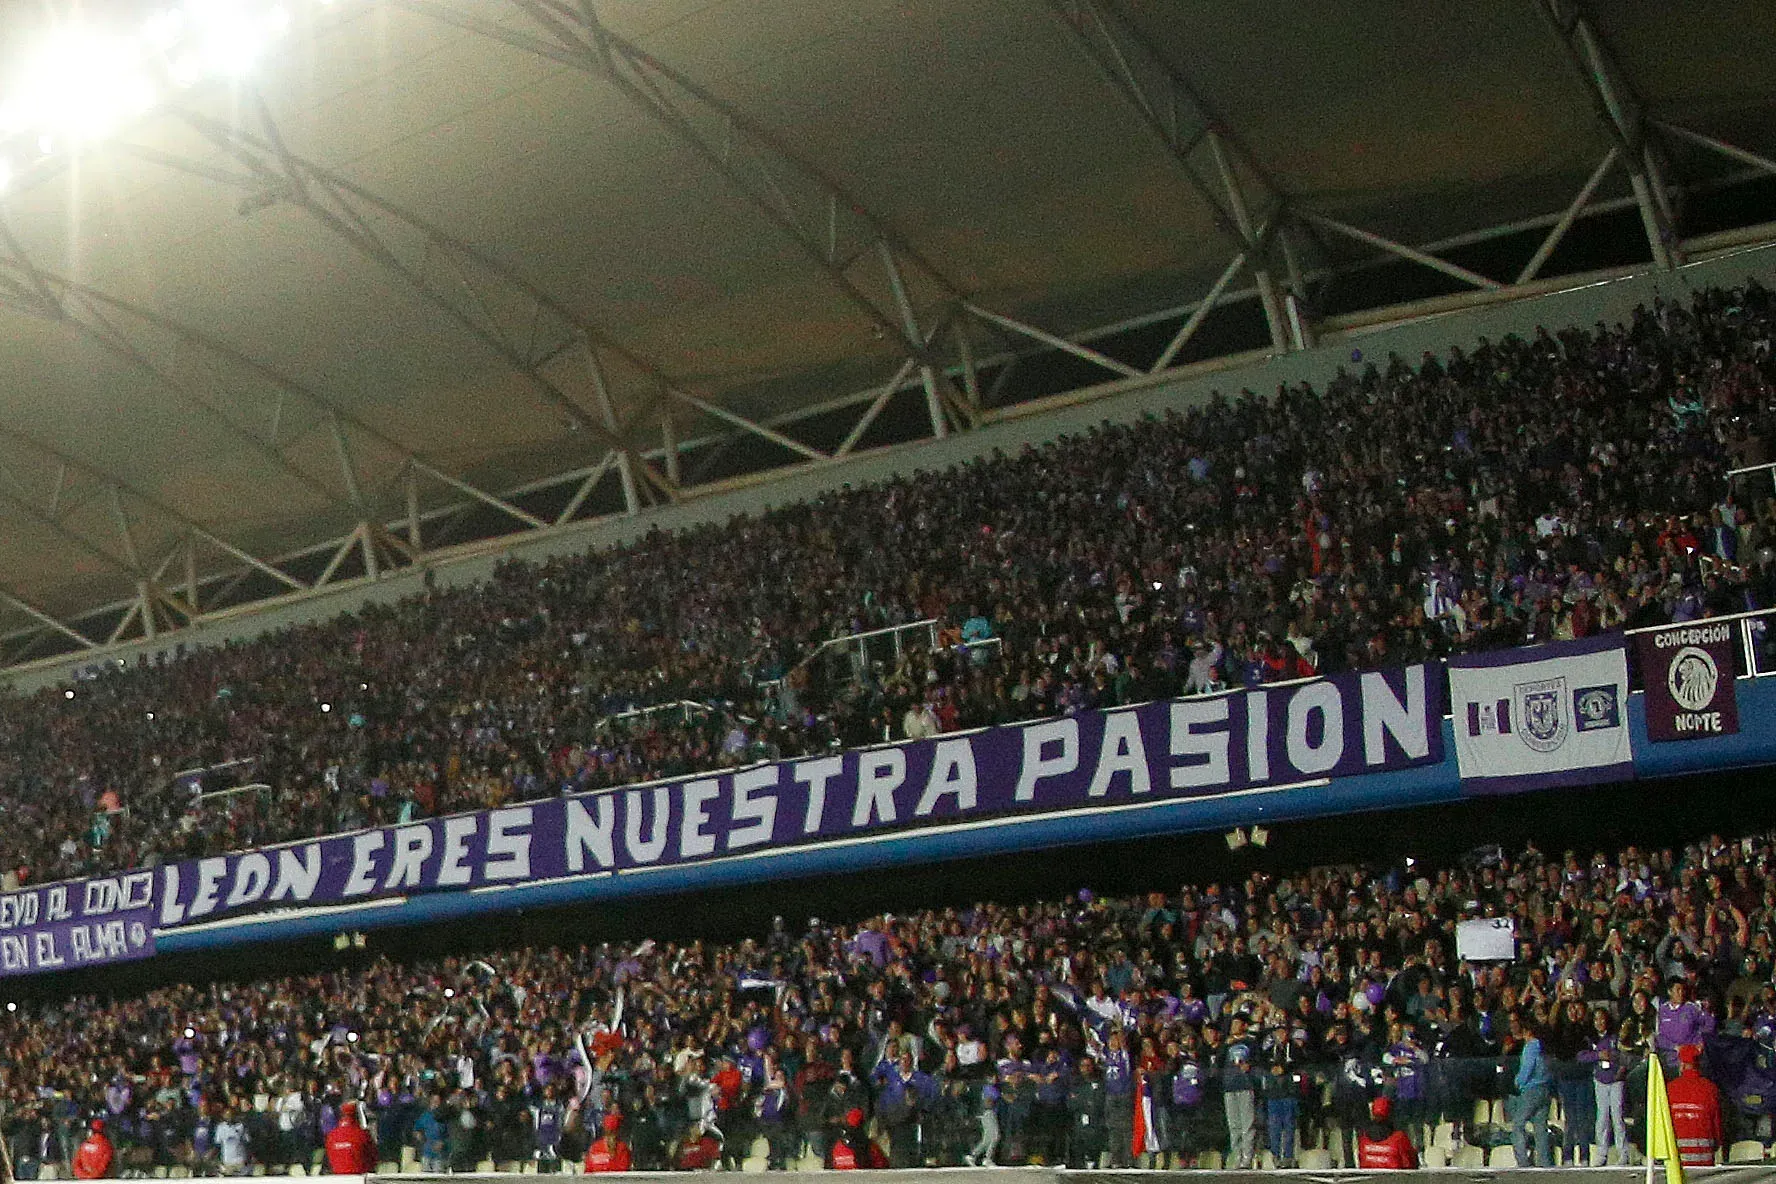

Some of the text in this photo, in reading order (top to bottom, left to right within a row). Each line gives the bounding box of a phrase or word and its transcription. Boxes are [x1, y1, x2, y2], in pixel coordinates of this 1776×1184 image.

[1674, 712, 1723, 732] NORTE
[159, 664, 1429, 926] LEON ERES NUESTRA PASION
[46, 886, 72, 921] AL
[1, 919, 128, 970] EN EL ALMA
